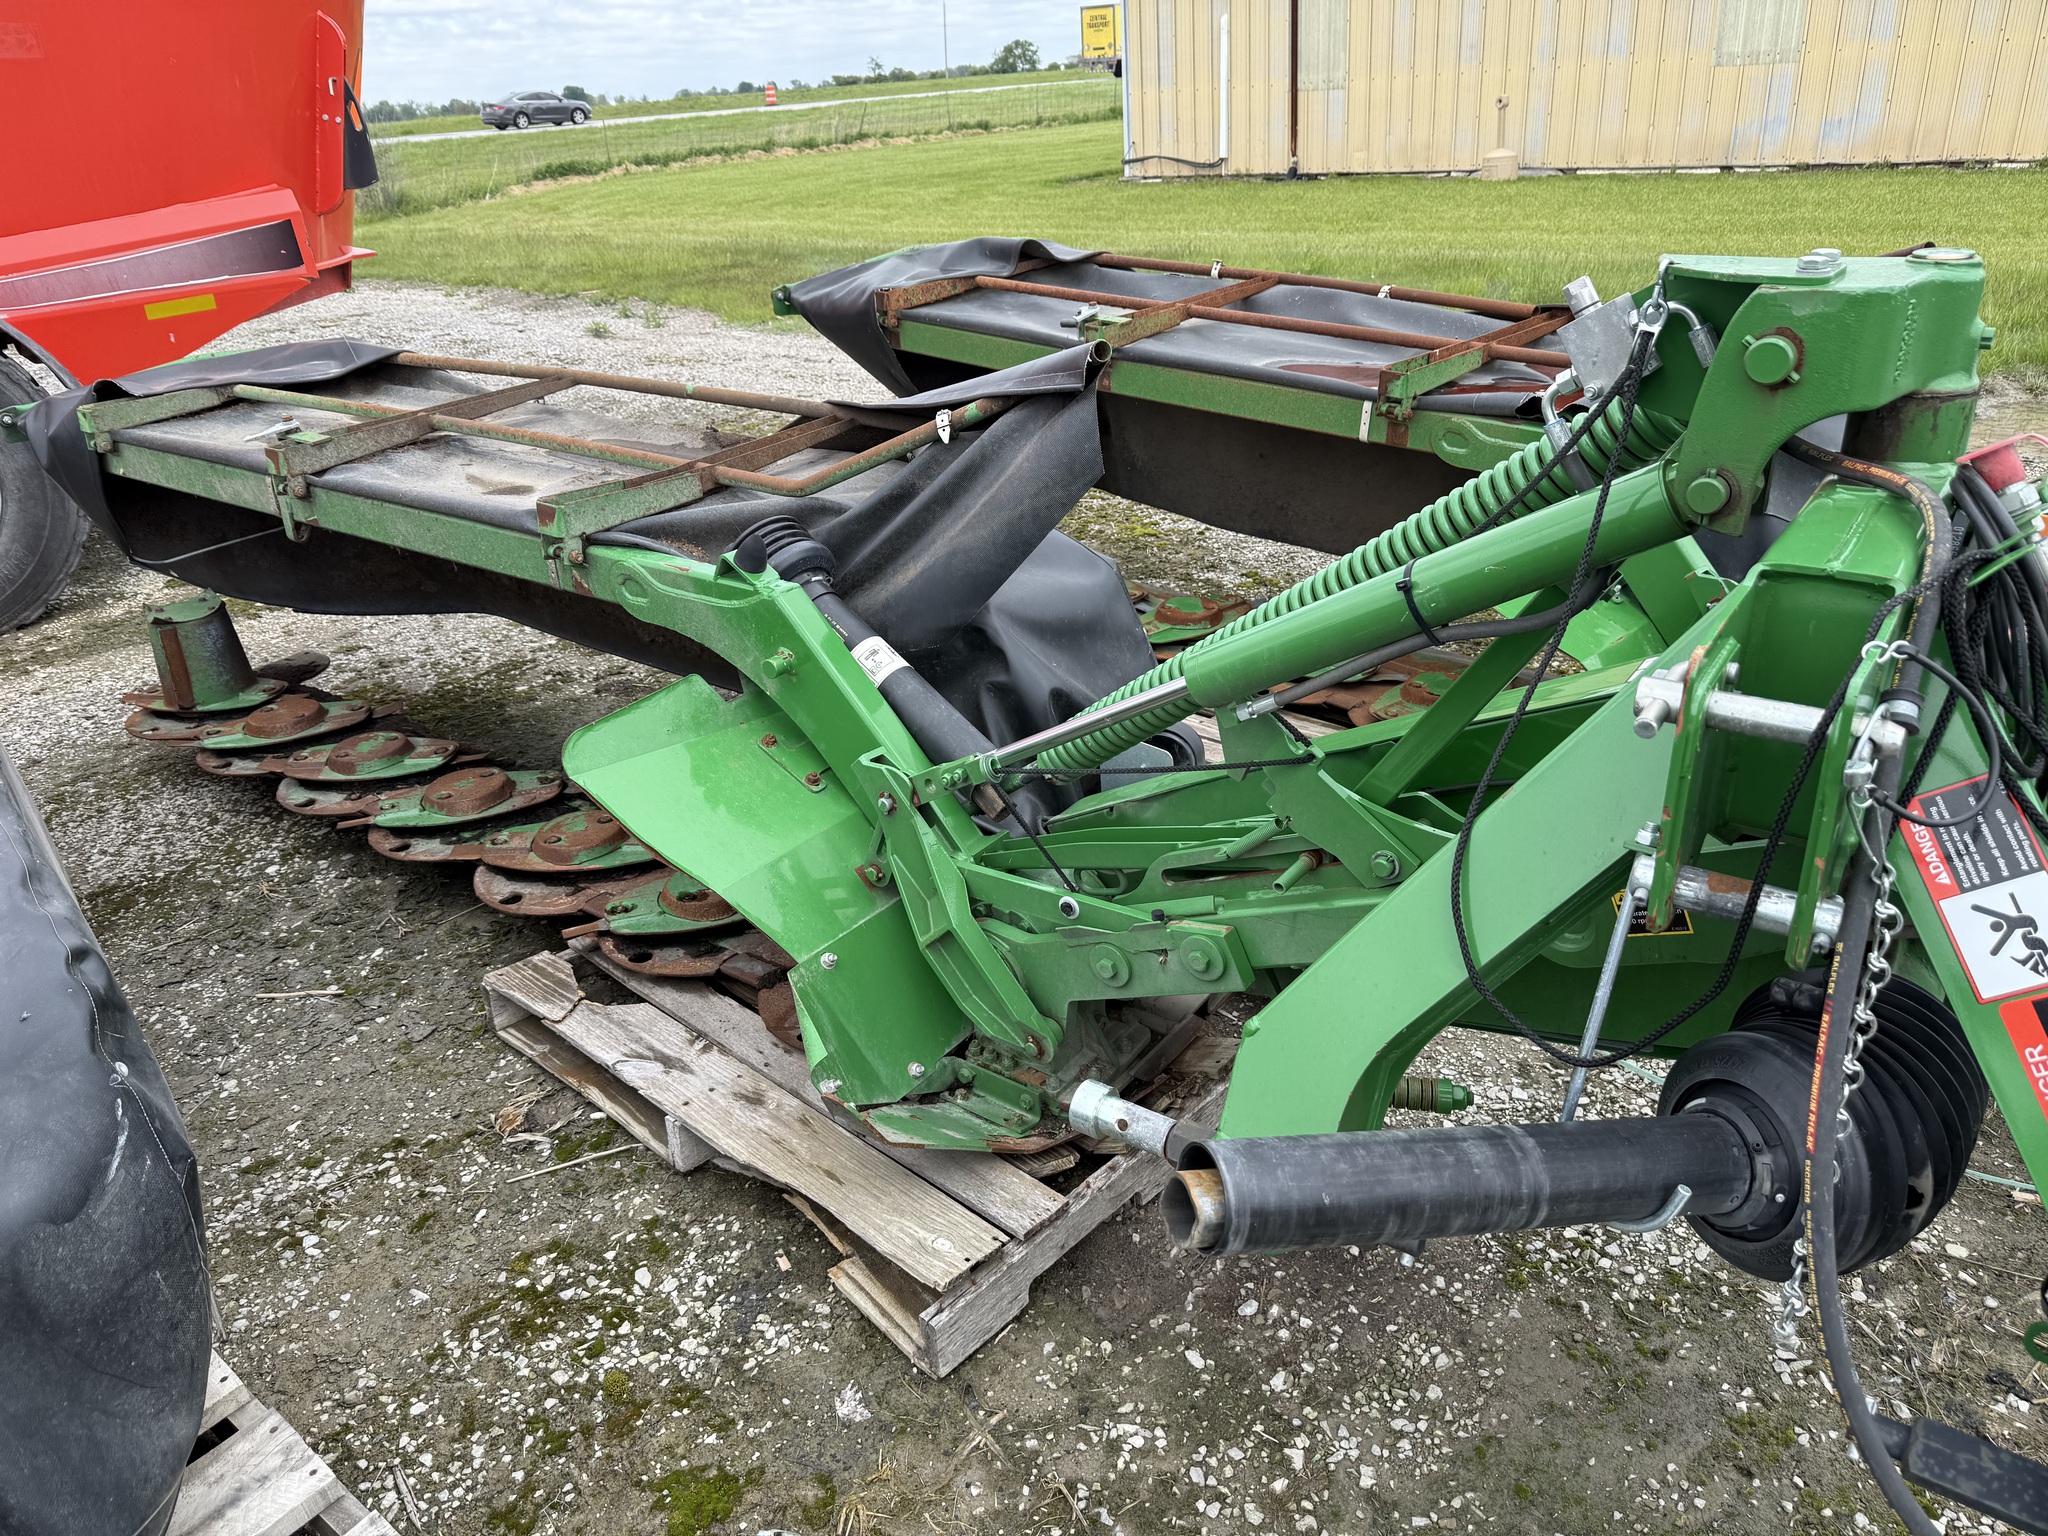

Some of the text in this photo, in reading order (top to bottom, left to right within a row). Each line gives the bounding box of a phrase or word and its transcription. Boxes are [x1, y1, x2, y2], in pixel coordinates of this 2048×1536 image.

[1087, 21, 1110, 29] TRANSPORT
[1808, 449, 1834, 461] BALFLEX
[1841, 461, 1867, 472] BALPAC
[1977, 815, 1984, 823] in
[1995, 808, 2006, 824] with
[1908, 810, 1946, 875] DANGE
[1942, 832, 1949, 841] in
[1956, 841, 1966, 854] can
[1963, 831, 1976, 853] death.
[1981, 823, 1996, 848] shields
[2002, 824, 2019, 850] contact
[2013, 819, 2039, 868] rotating parts.
[1944, 841, 1971, 888] Entanglement
[1991, 847, 2001, 858] all
[2014, 850, 2029, 870] Avoid
[1963, 854, 1980, 885] driveline
[1997, 858, 2010, 877] Keep
[1827, 955, 1840, 995] BALFLEX
[1816, 1013, 1829, 1055] BALPAC
[1809, 1062, 1821, 1112] PREMIUM
[1806, 1112, 1816, 1151] R16-6K
